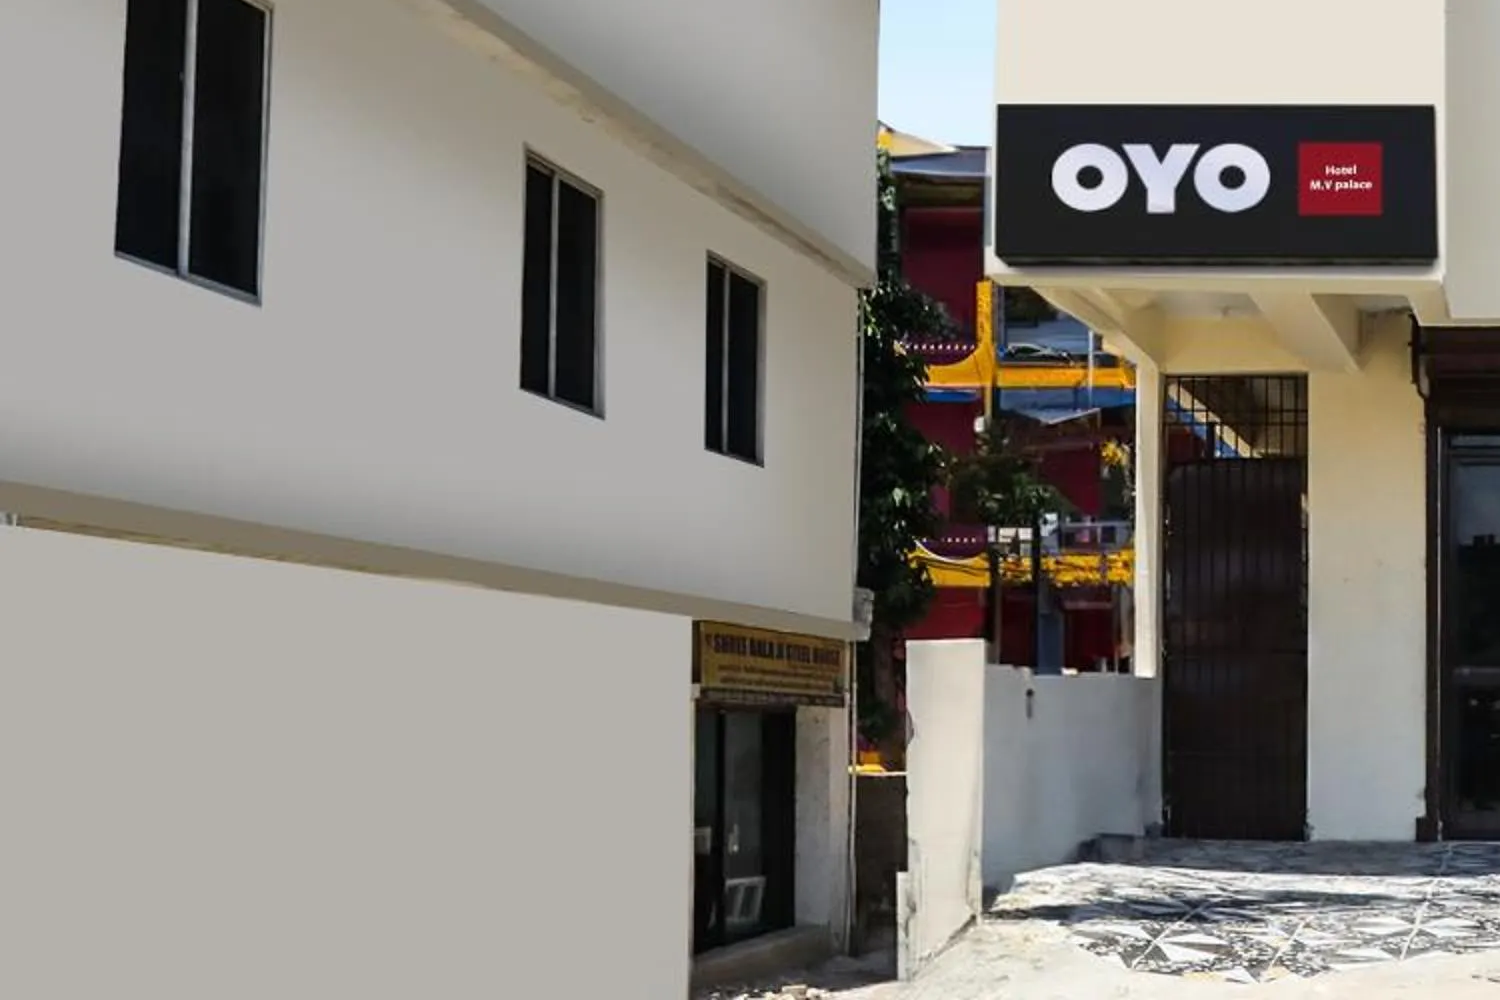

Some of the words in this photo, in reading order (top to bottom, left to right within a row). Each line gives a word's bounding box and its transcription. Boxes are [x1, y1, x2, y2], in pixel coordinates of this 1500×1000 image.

[1325, 164, 1357, 176] Hotel
[1051, 143, 1271, 213] OYO
[1310, 180, 1333, 191] M.V
[1335, 180, 1373, 192] palace
